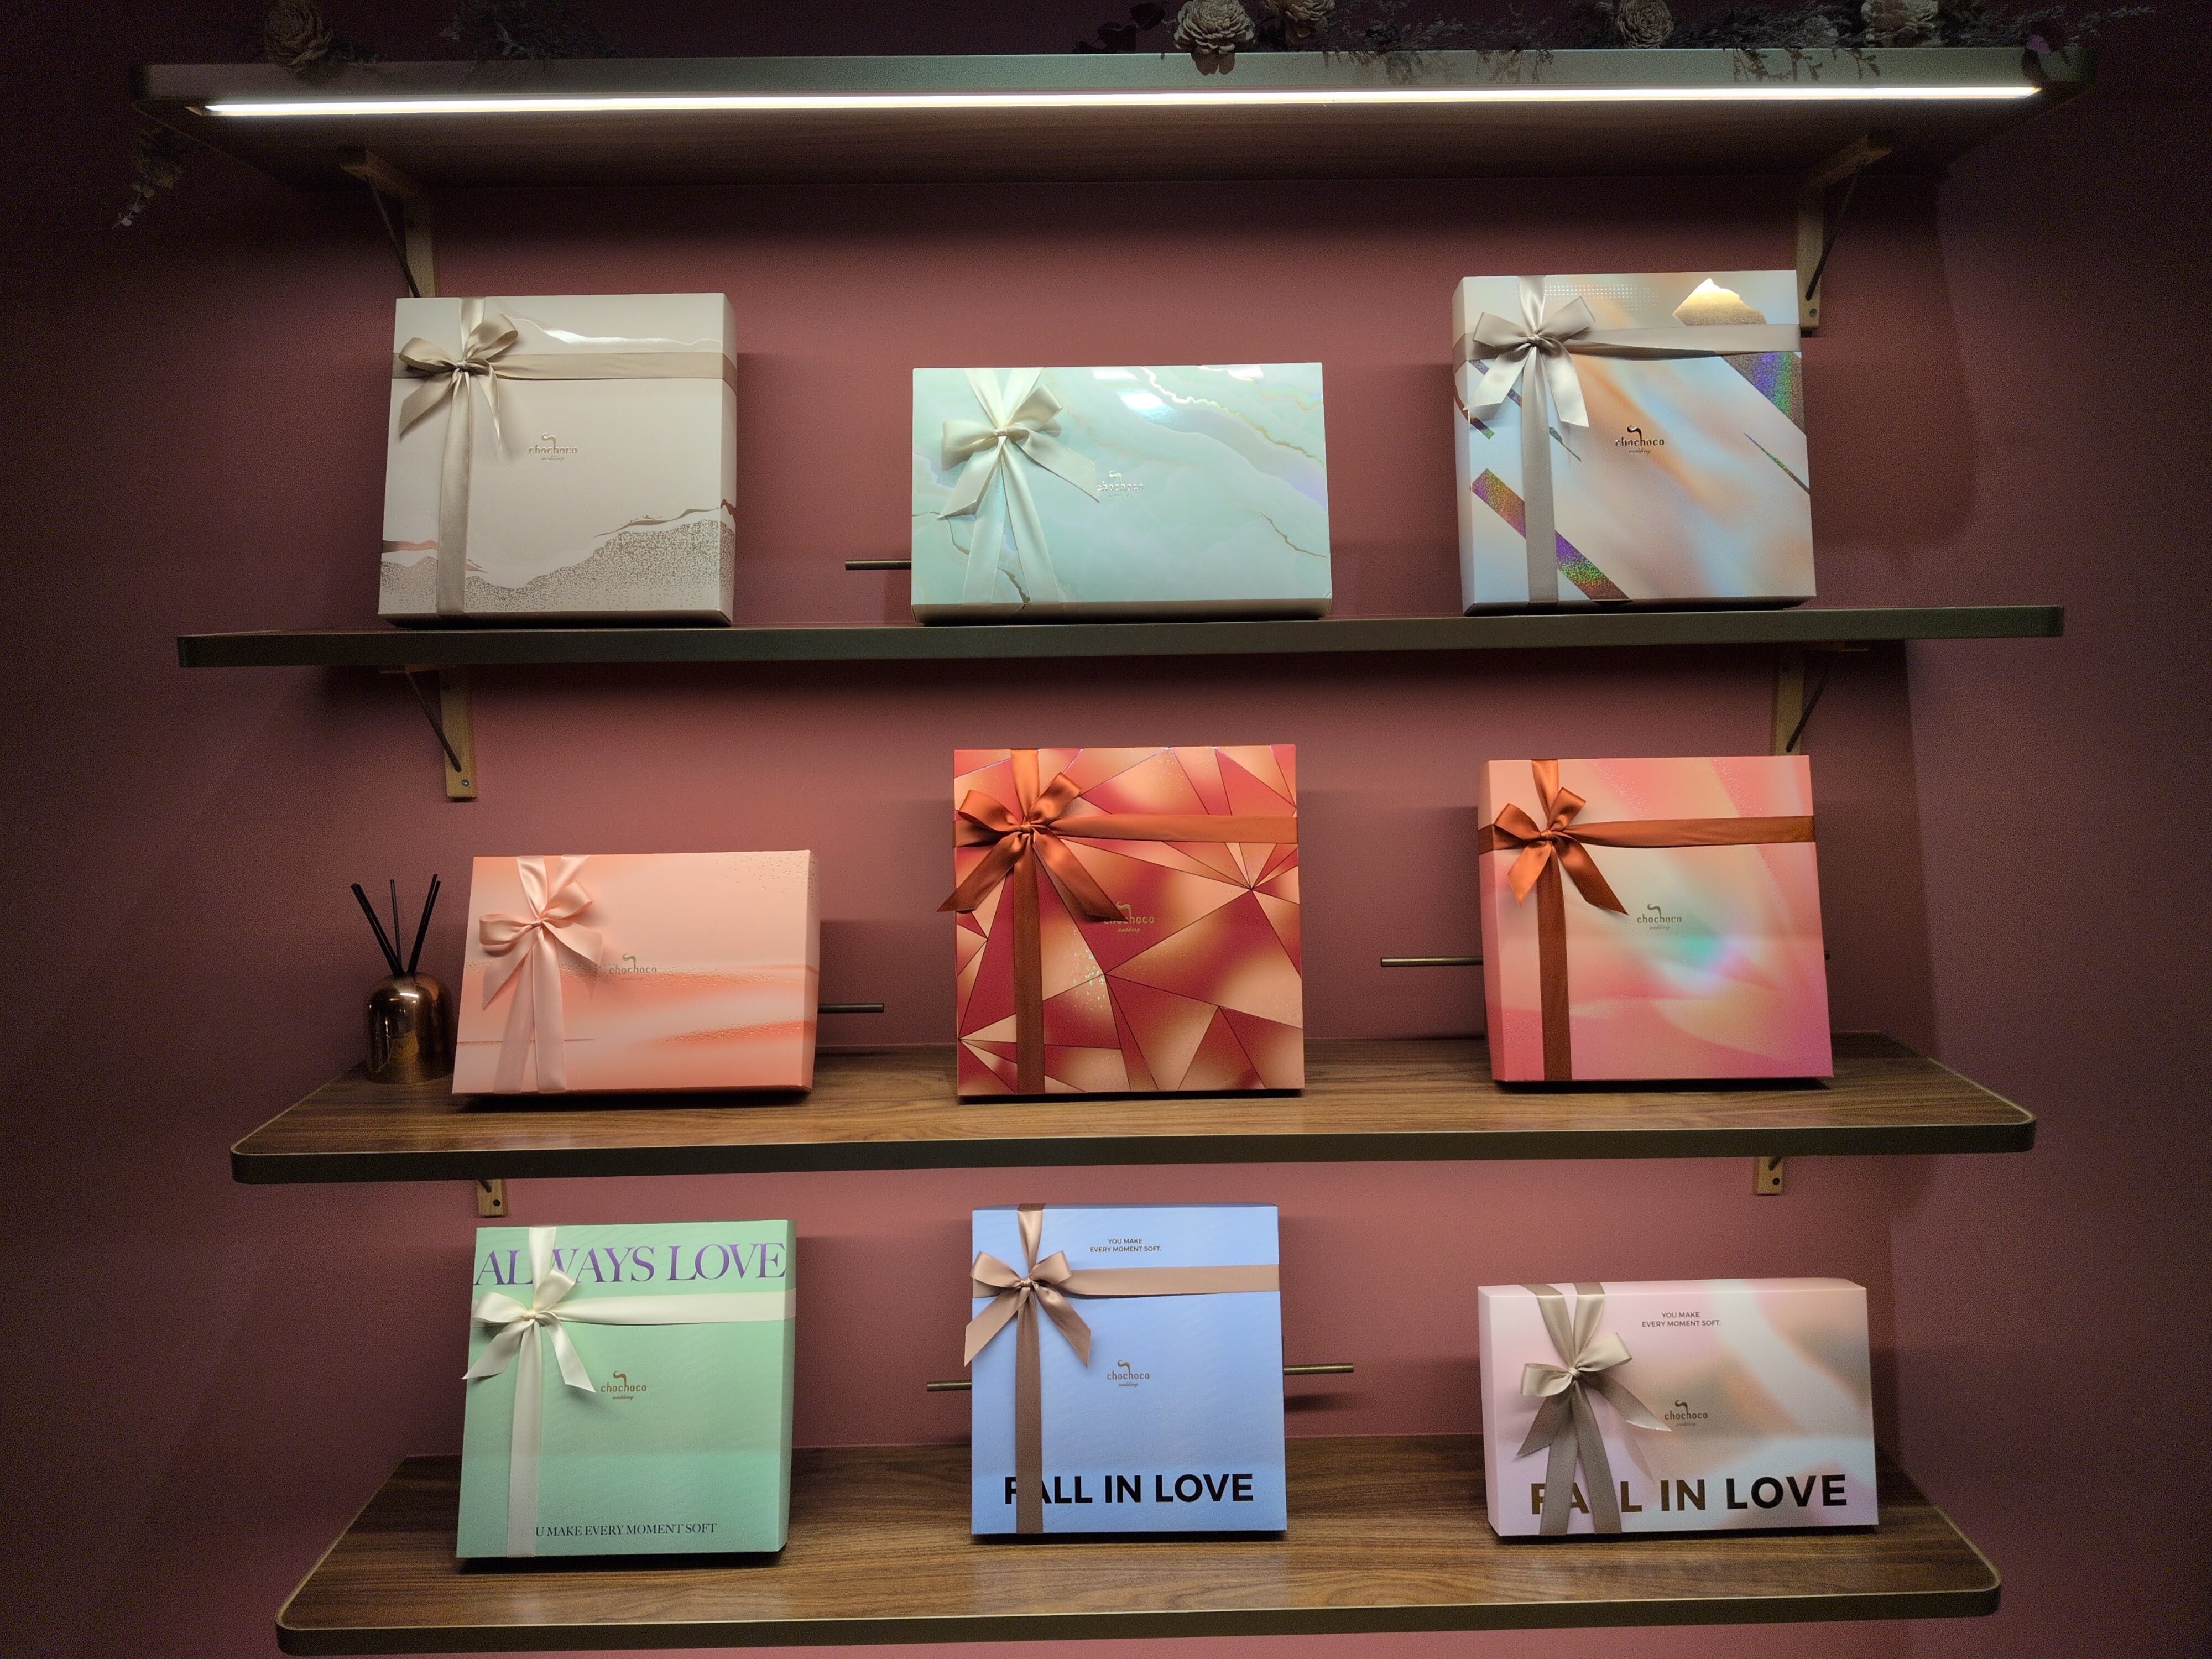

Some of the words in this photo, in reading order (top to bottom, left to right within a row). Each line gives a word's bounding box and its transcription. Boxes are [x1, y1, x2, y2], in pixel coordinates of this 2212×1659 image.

[666, 1242, 786, 1281] LOVE
[1105, 1475, 1141, 1503] IN
[1156, 1474, 1254, 1503] LOVE
[1531, 1481, 1642, 1515] FAL
[1660, 1479, 1705, 1511] IN
[1726, 1474, 1848, 1510] LOVE
[547, 1526, 582, 1536] MAKE
[585, 1525, 625, 1535] EVERY
[626, 1524, 684, 1535] MOMENT
[685, 1523, 717, 1533] SOFT
